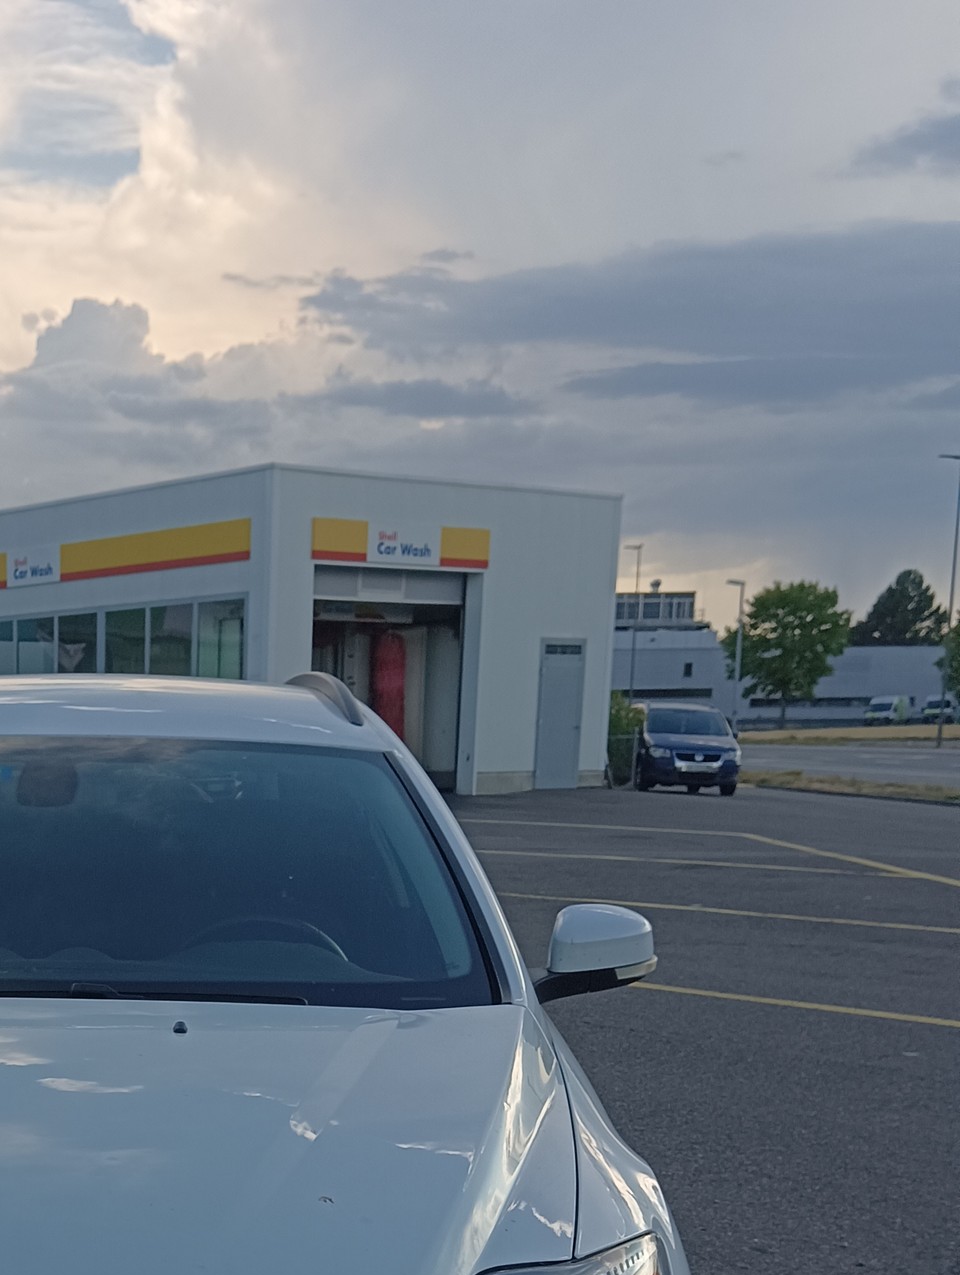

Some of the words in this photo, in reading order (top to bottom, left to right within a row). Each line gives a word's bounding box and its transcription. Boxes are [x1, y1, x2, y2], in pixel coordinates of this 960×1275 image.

[377, 541, 396, 555] Car
[400, 543, 431, 557] Wash
[13, 568, 28, 579] Car
[30, 563, 53, 577] Wash
